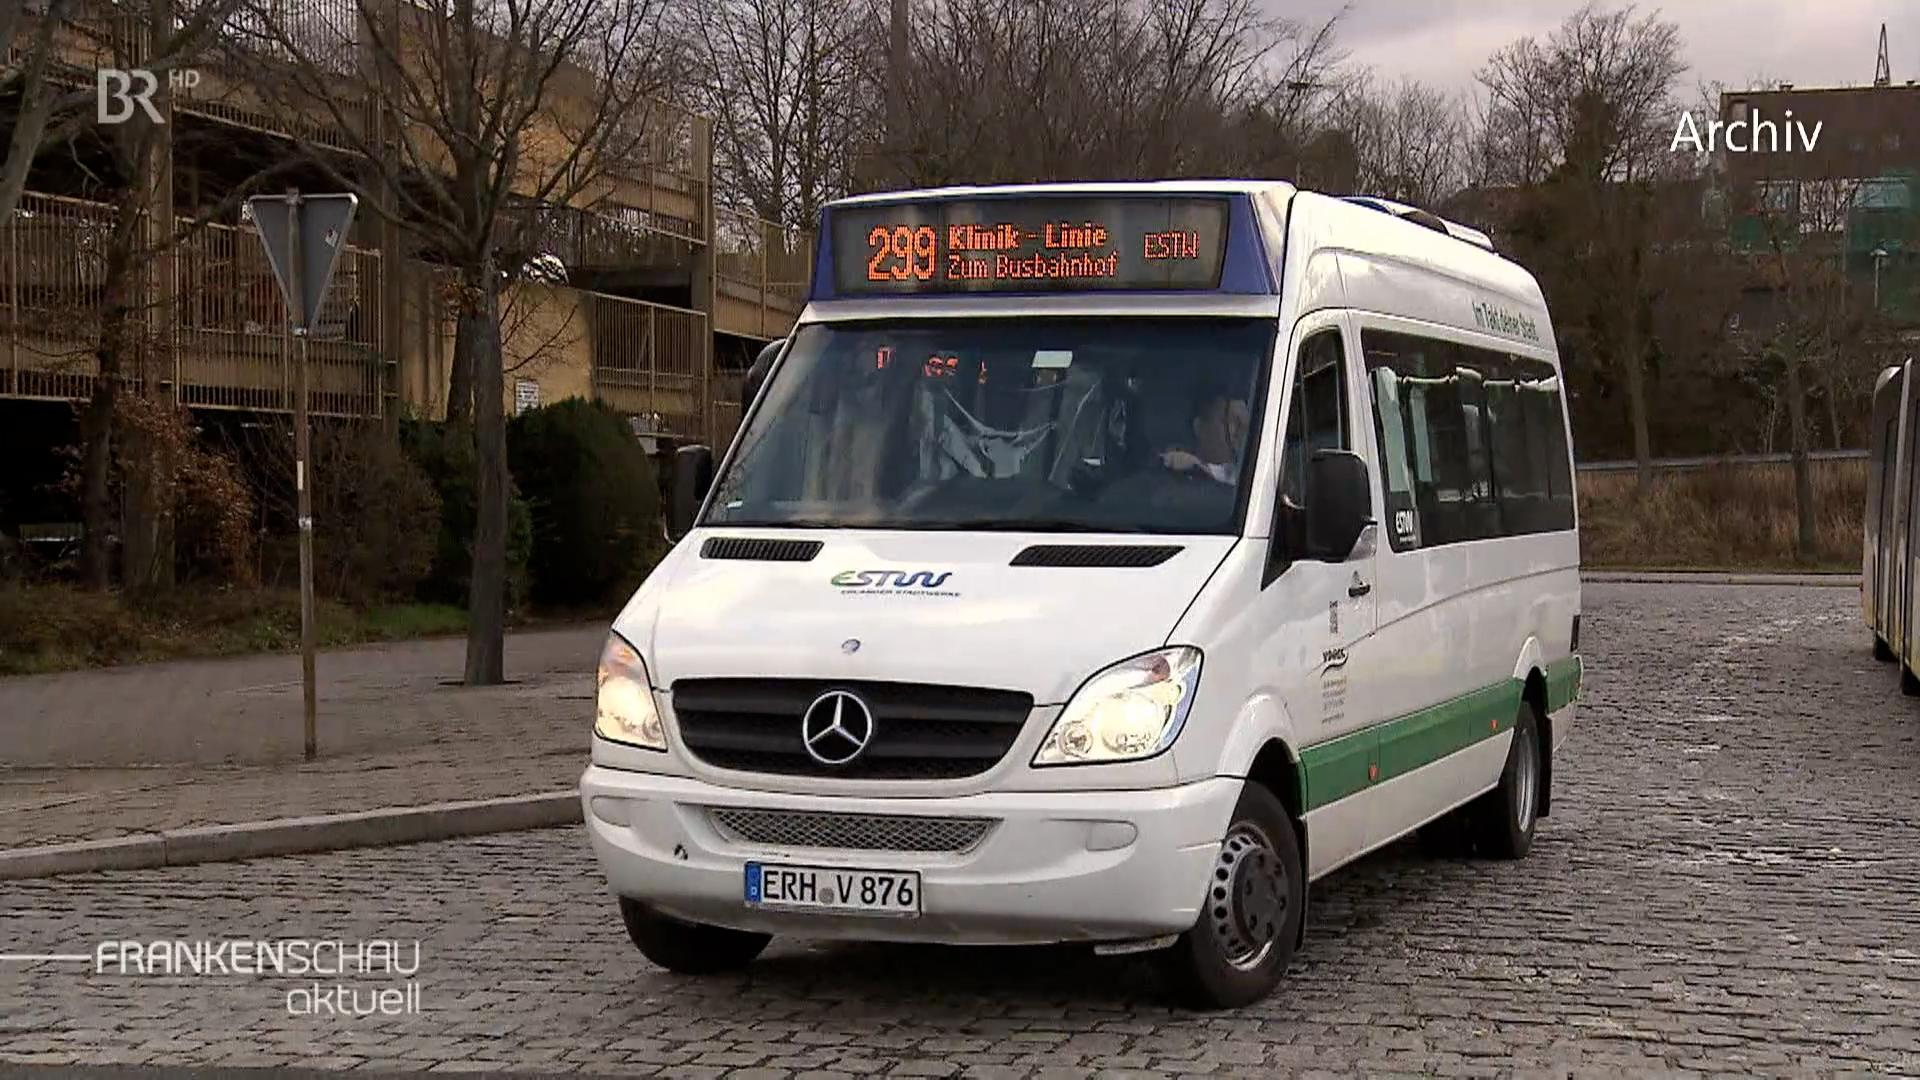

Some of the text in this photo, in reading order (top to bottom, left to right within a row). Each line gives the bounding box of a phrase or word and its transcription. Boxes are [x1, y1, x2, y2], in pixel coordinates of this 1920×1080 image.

[949, 224, 1019, 250] Klinik
[1045, 222, 1108, 249] Linie
[1144, 231, 1199, 259] ESTW
[868, 226, 936, 280] 299
[948, 251, 1118, 279] Zum Busbahnhof
[750, 886, 758, 896] D
[763, 870, 913, 906] ERH V 876
